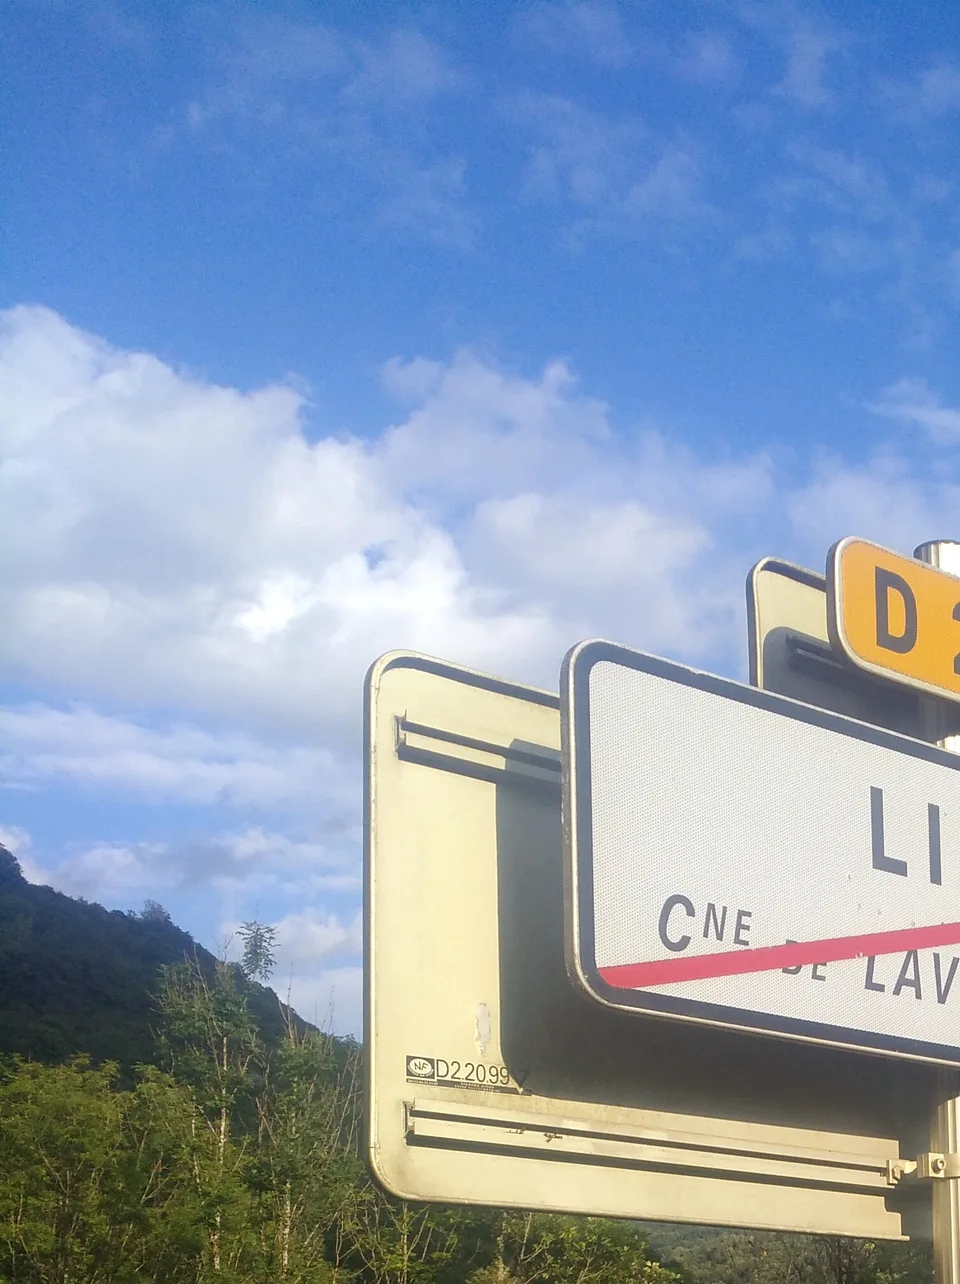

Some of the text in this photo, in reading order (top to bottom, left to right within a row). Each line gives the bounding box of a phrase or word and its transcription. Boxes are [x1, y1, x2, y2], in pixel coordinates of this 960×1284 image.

[875, 565, 918, 655] D
[413, 1061, 429, 1071] NF
[436, 1059, 510, 1085] D2.20.99
